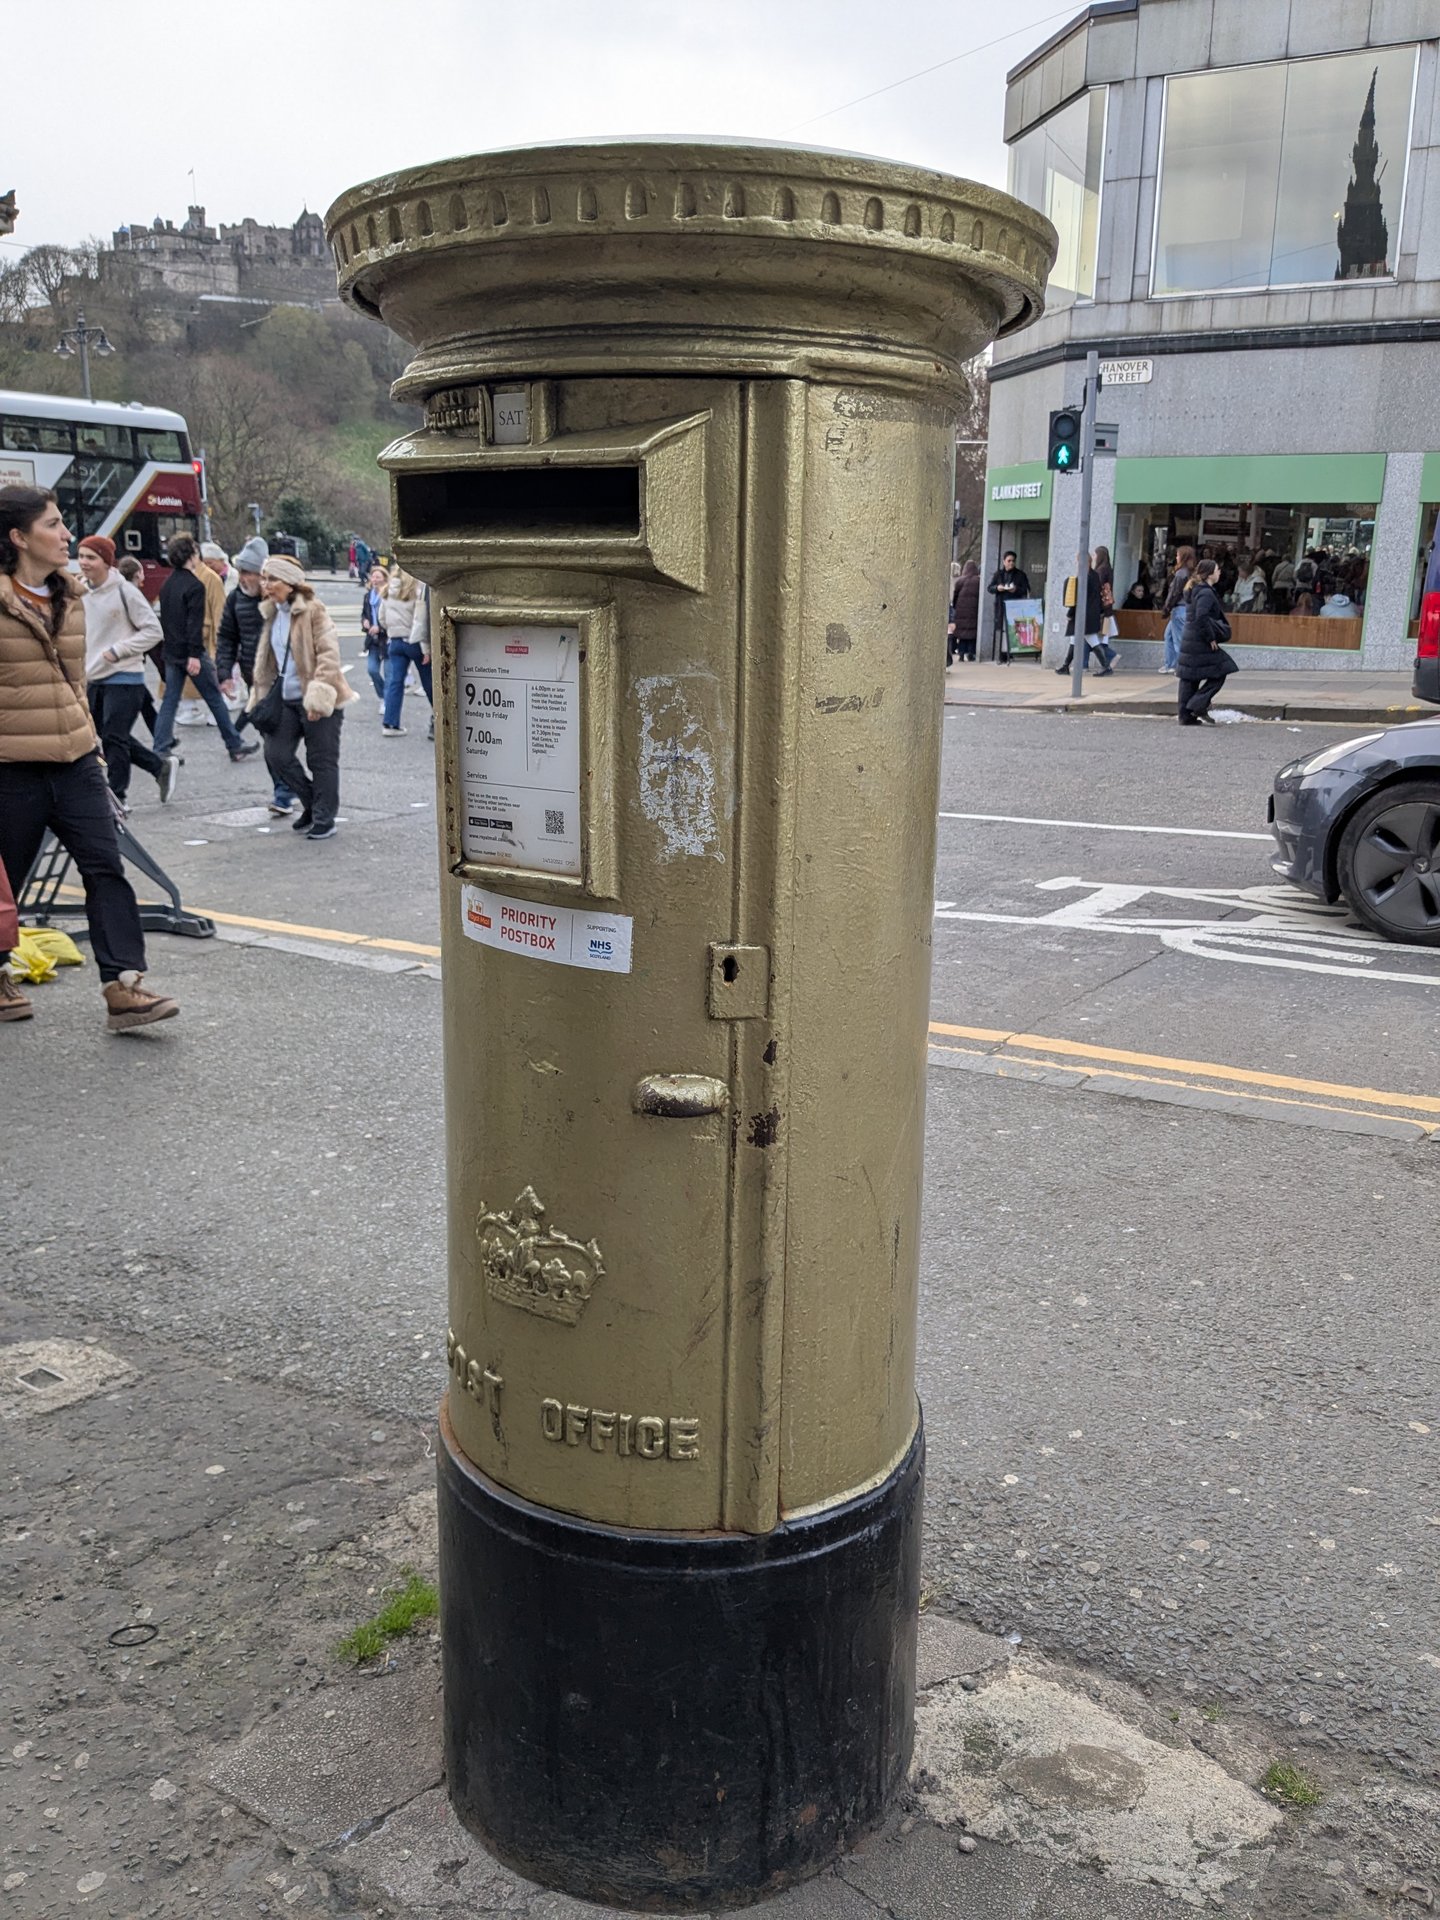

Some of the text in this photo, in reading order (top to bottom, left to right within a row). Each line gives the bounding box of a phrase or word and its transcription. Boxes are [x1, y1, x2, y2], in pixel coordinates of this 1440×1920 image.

[1102, 361, 1148, 372] HANOVER
[1107, 372, 1142, 382] STREET
[498, 410, 524, 426] SAT
[158, 496, 182, 507] Lothian
[465, 683, 515, 708] 9.00am
[464, 710, 484, 718] Monday
[492, 712, 508, 720] Friday
[466, 726, 502, 745] 7.00am
[466, 747, 488, 756] Saturday
[466, 771, 488, 779] Services
[480, 916, 490, 926] Mail
[501, 906, 557, 931] PRIORITY
[586, 924, 616, 934] SUPPORTING
[500, 926, 556, 951] POSTBOX
[590, 939, 612, 951] NHS
[541, 1398, 699, 1460] OFFICE
